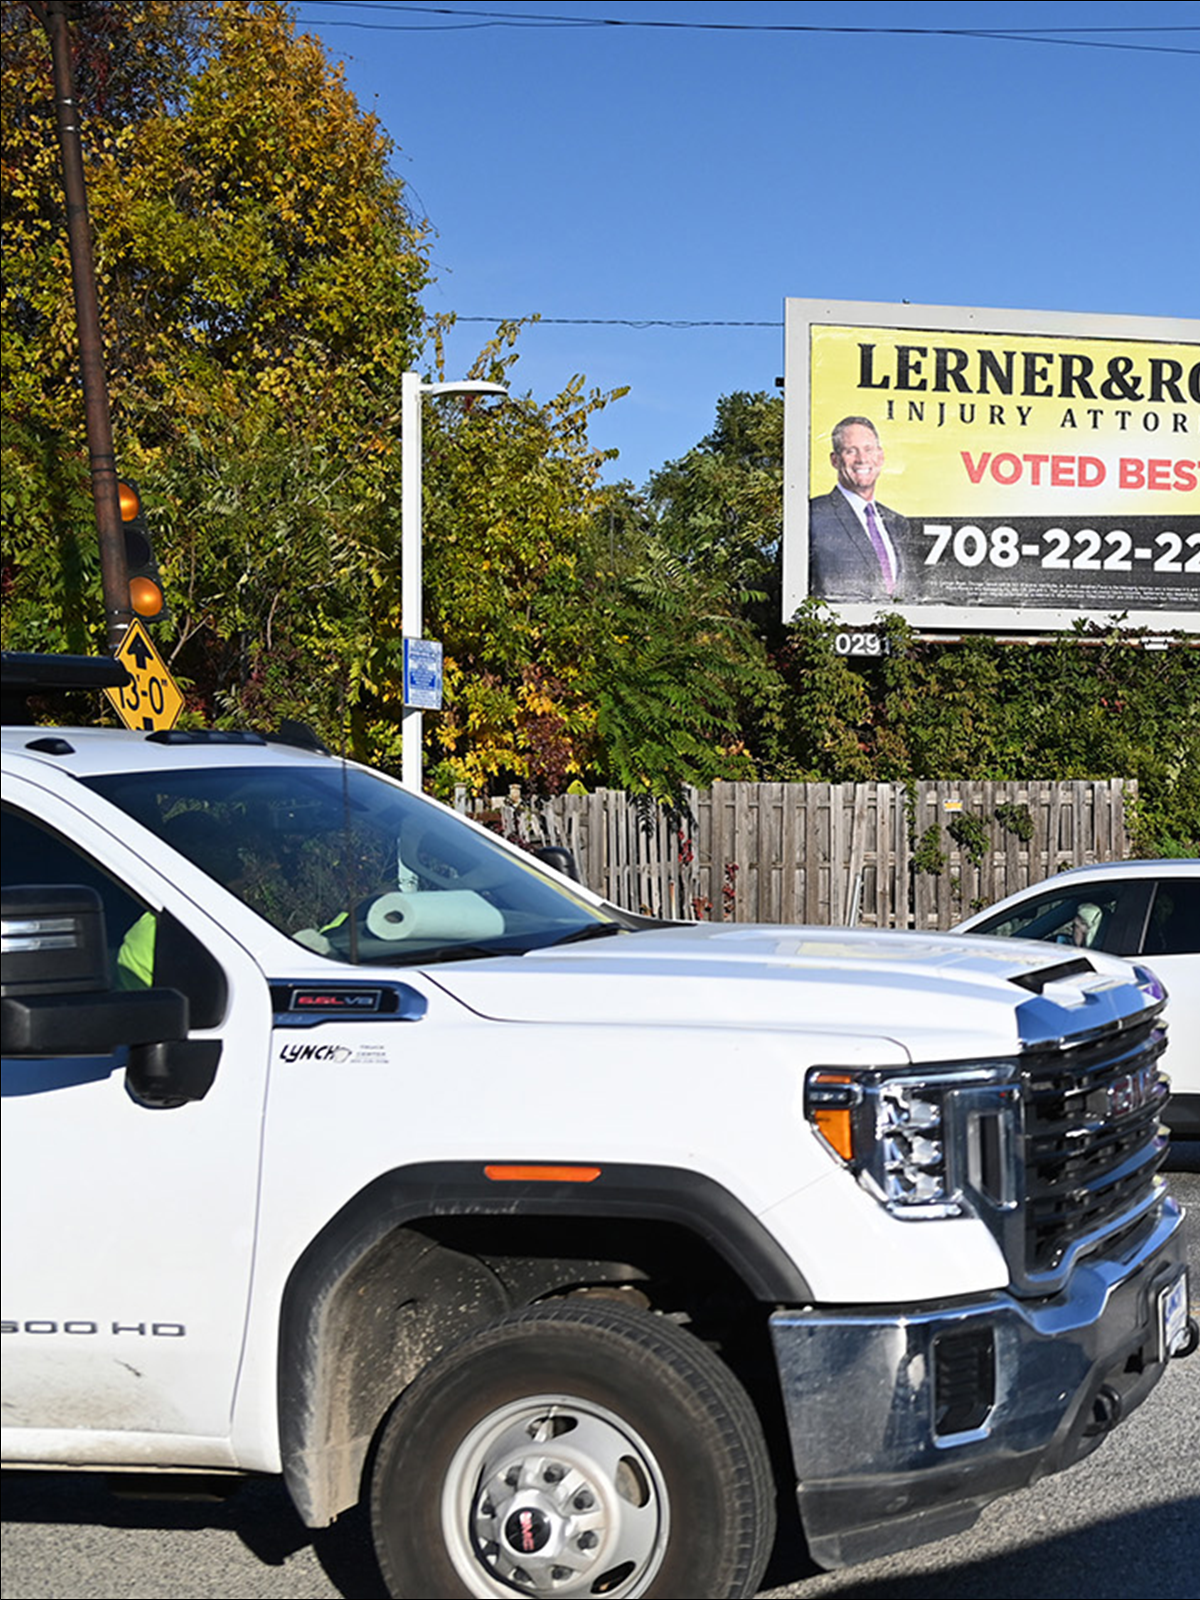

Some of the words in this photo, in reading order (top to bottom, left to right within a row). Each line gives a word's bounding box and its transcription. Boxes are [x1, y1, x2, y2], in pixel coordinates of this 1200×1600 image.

[887, 400, 1032, 427] INJURY
[960, 451, 1107, 488] VOTED
[280, 1044, 340, 1063] LYNCH
[111, 1322, 185, 1337] HD
